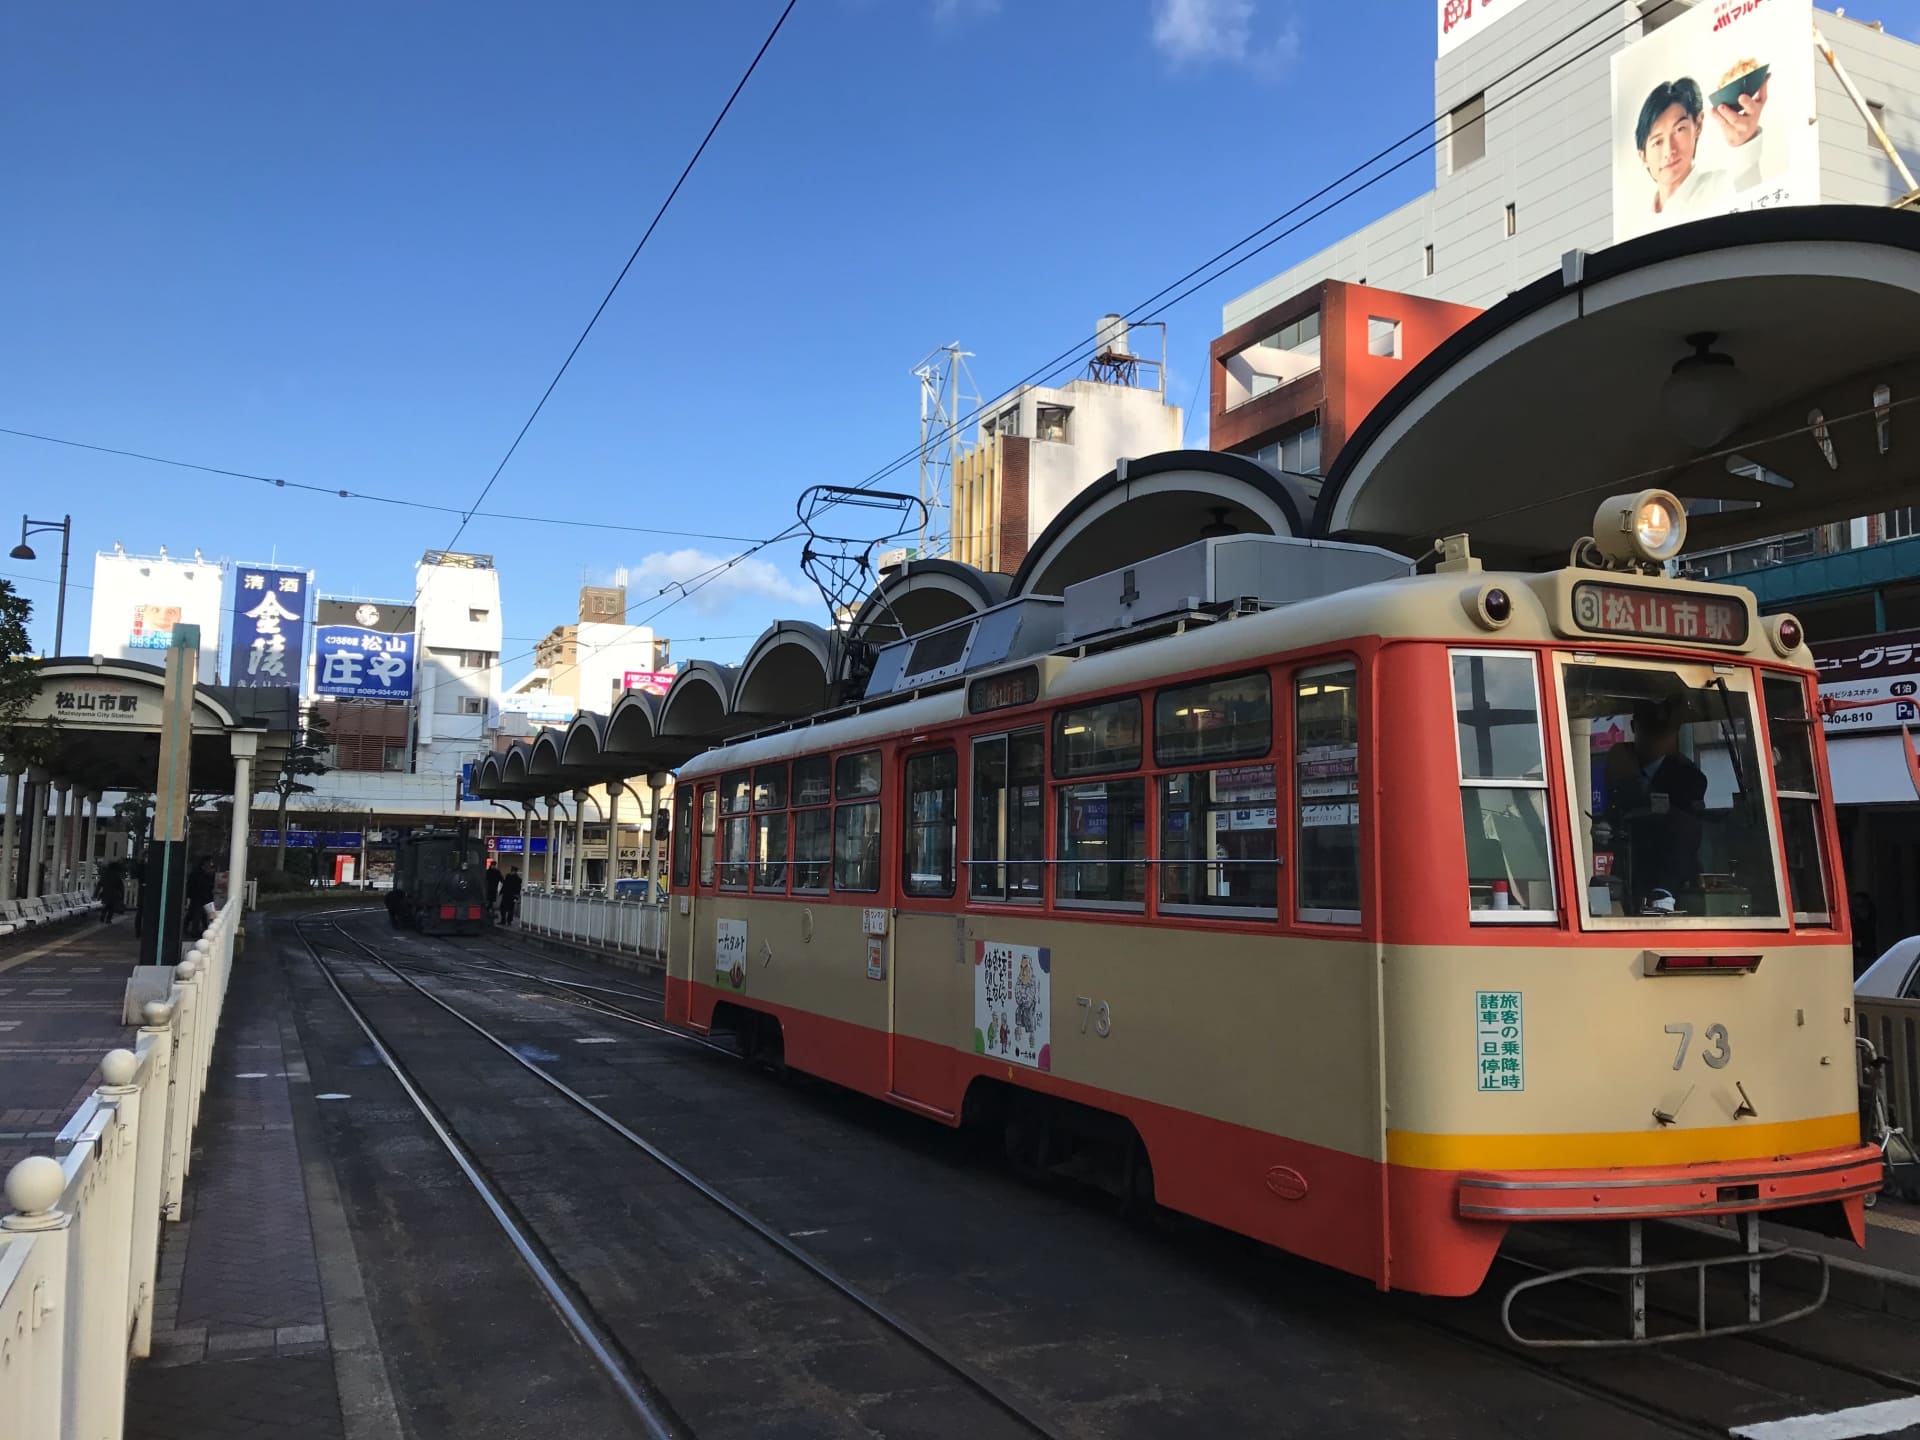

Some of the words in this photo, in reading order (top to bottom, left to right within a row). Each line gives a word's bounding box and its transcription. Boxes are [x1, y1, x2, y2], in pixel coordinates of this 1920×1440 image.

[244, 574, 299, 593] 清酒
[242, 590, 301, 678] 金陵
[1581, 596, 1595, 621] 3
[1606, 593, 1733, 640] 松山市駅
[361, 635, 407, 653] 松山
[322, 649, 407, 687] 庄や
[55, 691, 138, 713] 松山市駅
[1894, 684, 1912, 694] 1泊
[57, 710, 96, 718] Matsuyama
[1077, 996, 1111, 1038] 73
[1480, 994, 1500, 1089] 諸車一旦停止
[1500, 994, 1520, 1089] 旅客の乗降時
[1664, 1023, 1731, 1071] 73
